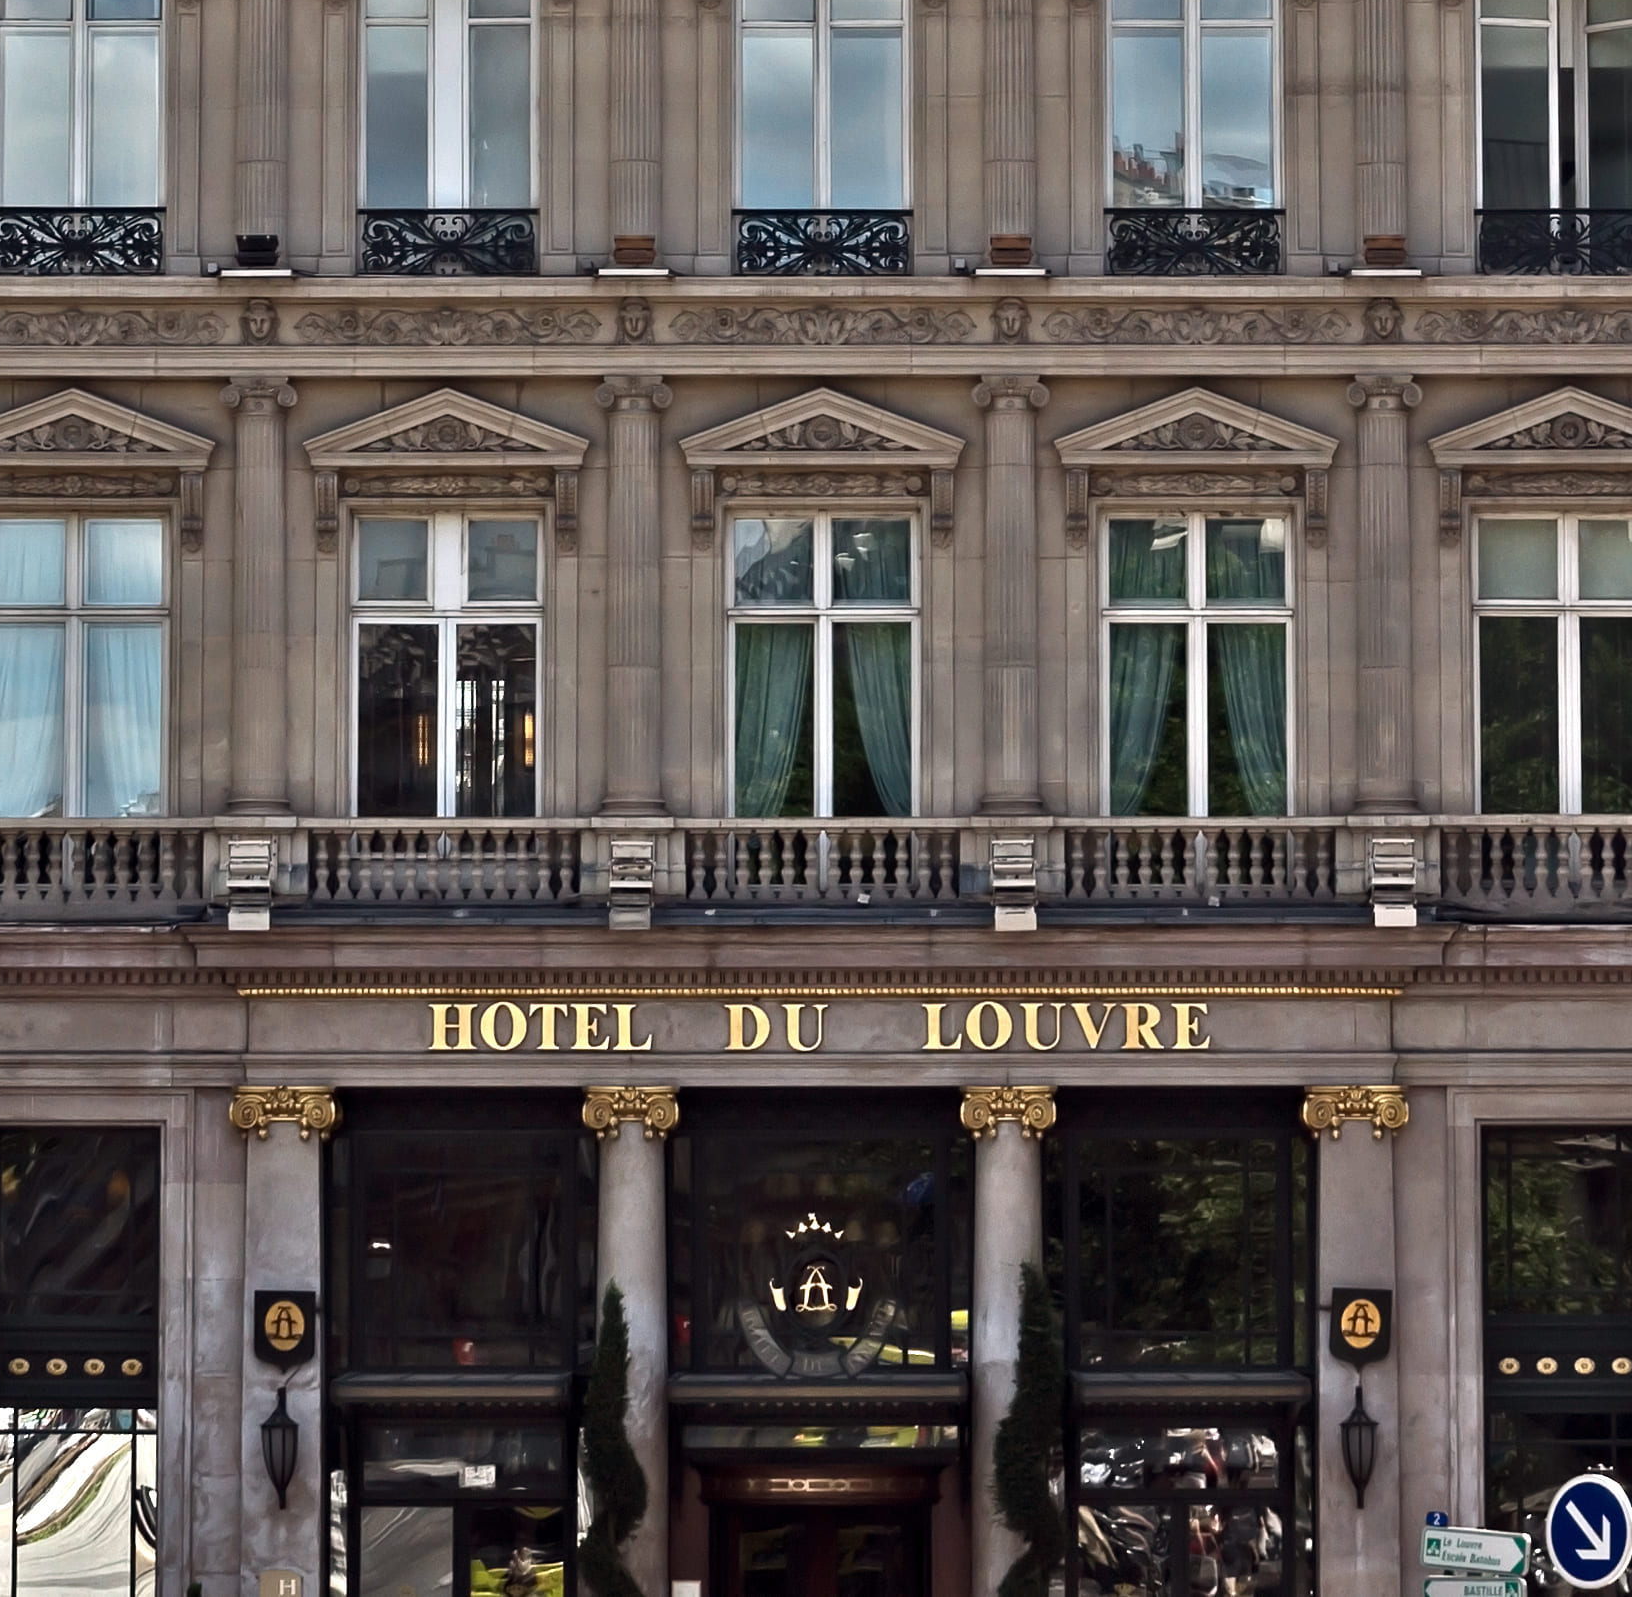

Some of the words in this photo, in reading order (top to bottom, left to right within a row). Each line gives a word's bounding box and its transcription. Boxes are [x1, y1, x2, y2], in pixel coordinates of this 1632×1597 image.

[428, 1002, 653, 1052] HOTEL
[724, 1003, 829, 1052] DU
[922, 1001, 1212, 1051] LOUVRE
[1433, 1513, 1440, 1525] 2
[1443, 1536, 1451, 1547] Le
[1456, 1537, 1483, 1549] Louvre
[279, 1580, 296, 1596] H
[1463, 1585, 1503, 1597] BASTILLE
